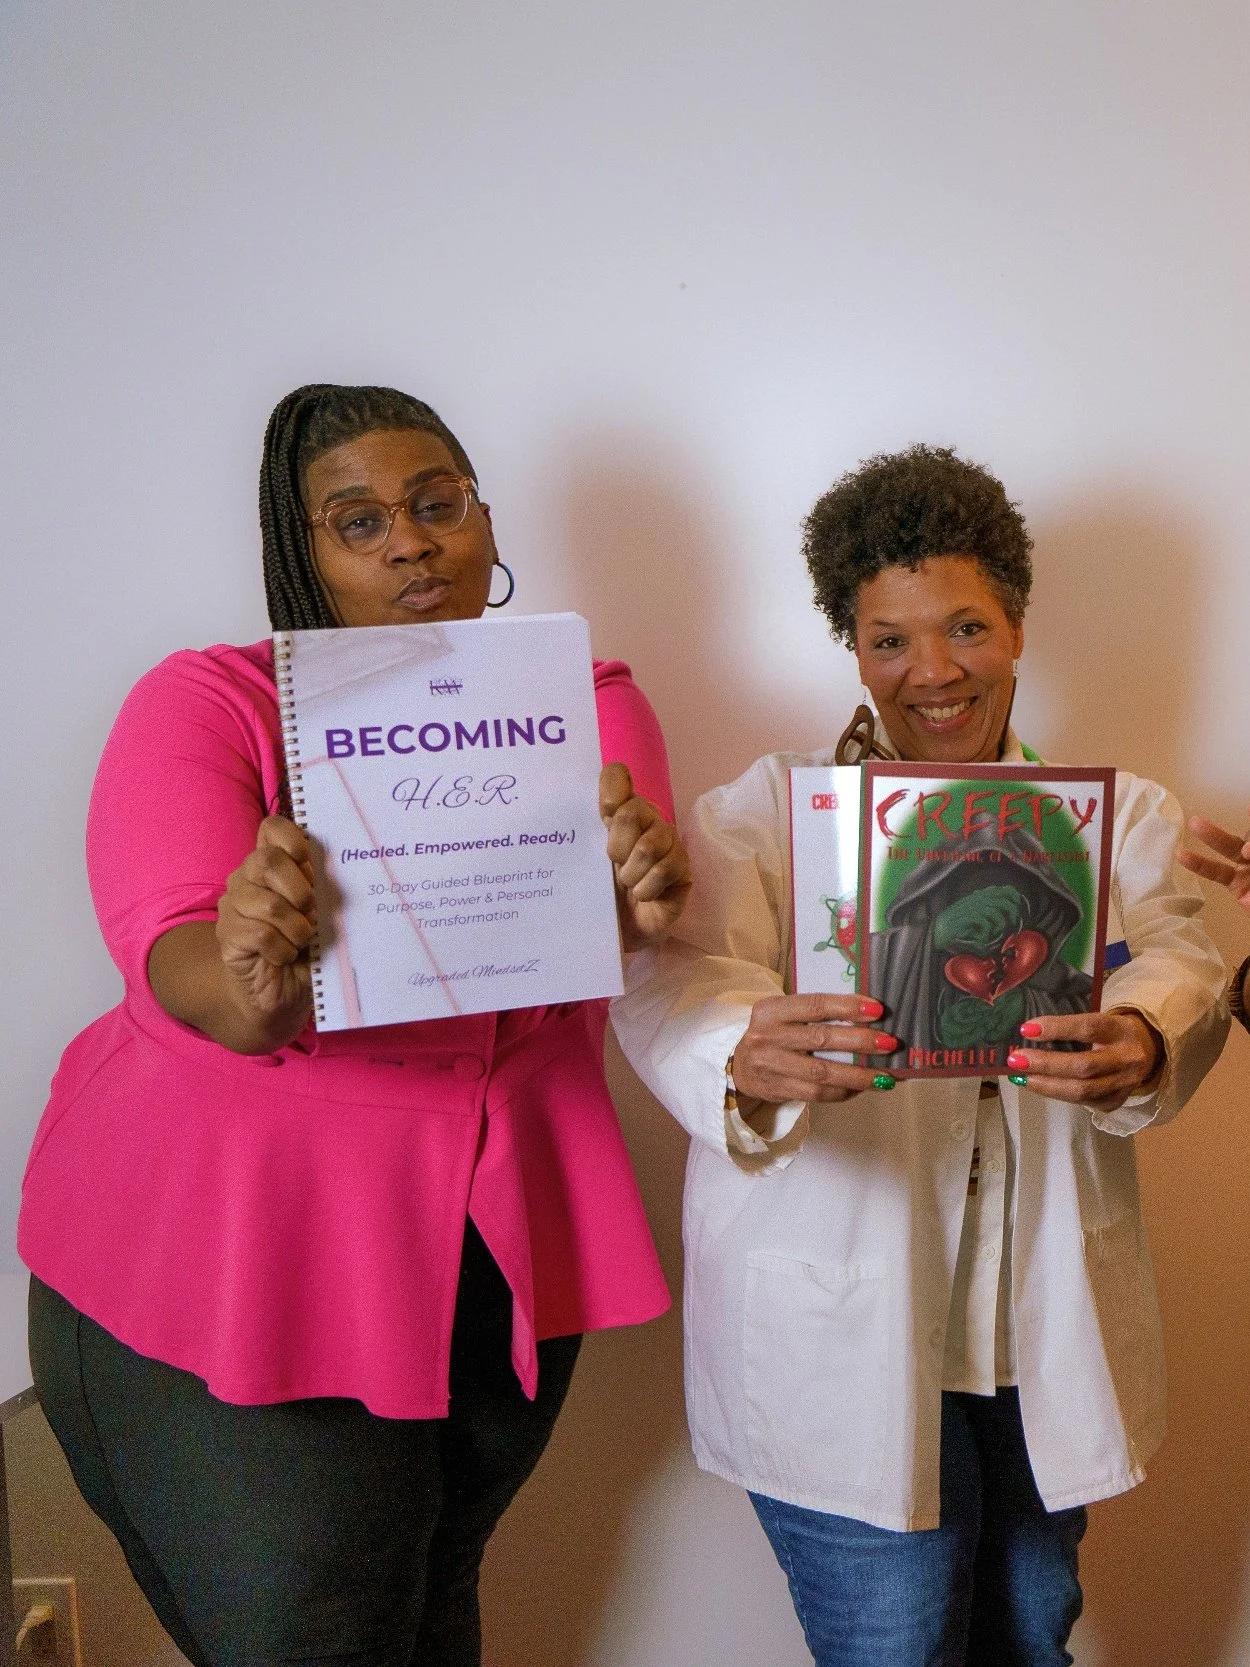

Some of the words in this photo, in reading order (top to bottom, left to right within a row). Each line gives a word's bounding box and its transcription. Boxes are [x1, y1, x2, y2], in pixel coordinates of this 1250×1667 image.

[324, 715, 567, 760] BECOMING
[391, 773, 519, 811] H.E.R.
[875, 788, 1098, 844] CREEPY
[341, 844, 409, 864] (Healed.
[414, 834, 514, 855] Empowered.
[519, 829, 576, 846] Ready.)
[367, 881, 418, 897] 30-Day
[421, 875, 470, 891] Guided
[474, 868, 534, 888] Blueprint
[537, 867, 555, 880] for
[376, 899, 436, 914] Purpose,
[440, 894, 482, 907] Power
[485, 892, 494, 903] &
[497, 886, 554, 901] Personal
[417, 908, 519, 929] Transformation
